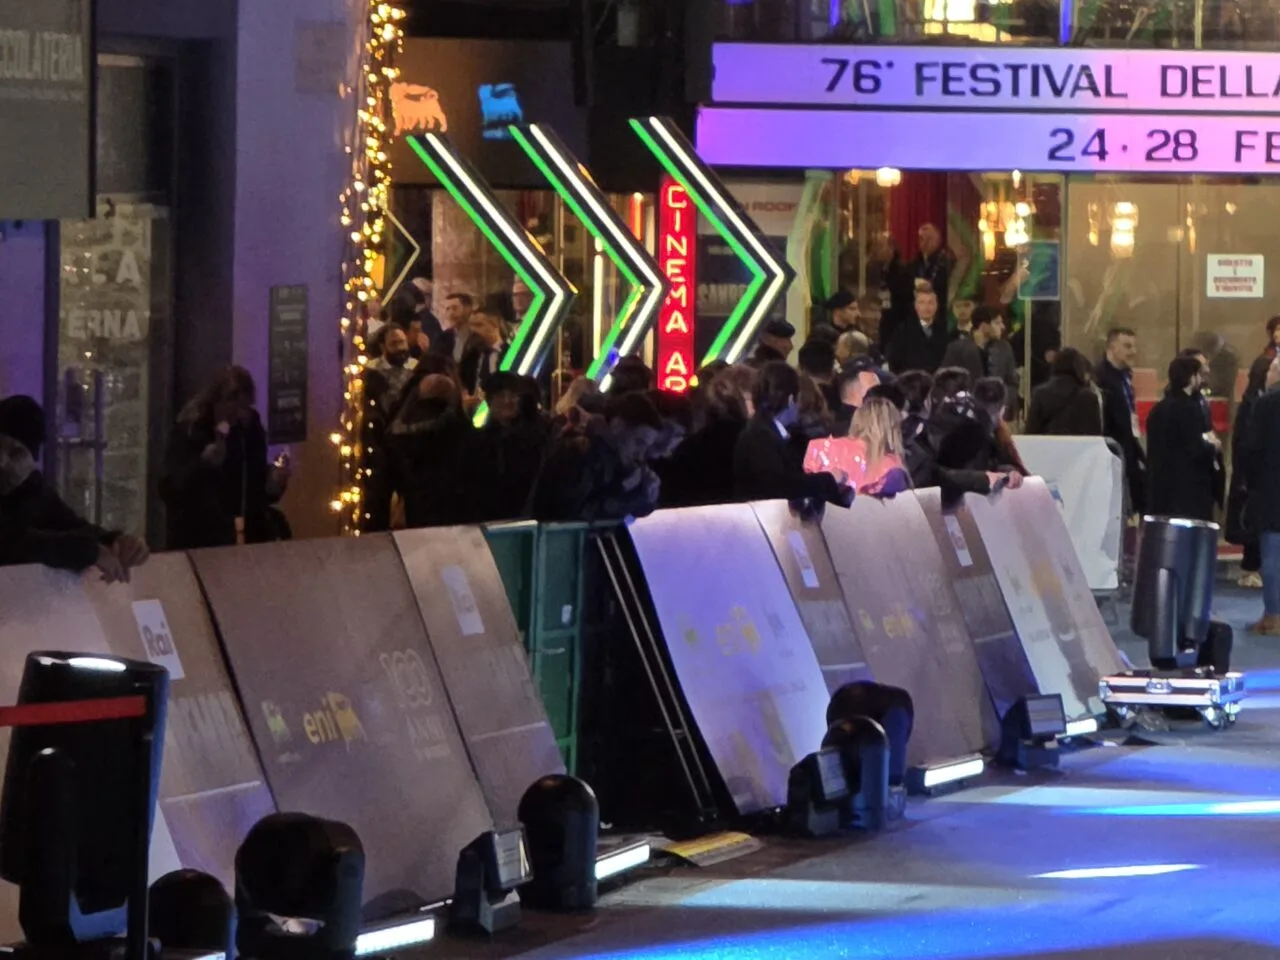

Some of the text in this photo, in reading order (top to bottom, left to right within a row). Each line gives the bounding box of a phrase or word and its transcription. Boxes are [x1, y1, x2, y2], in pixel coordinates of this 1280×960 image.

[914, 62, 1128, 98] FESTIVAL
[666, 186, 687, 333] CINEMA
[142, 621, 174, 657] Rai
[303, 696, 338, 744] eni
